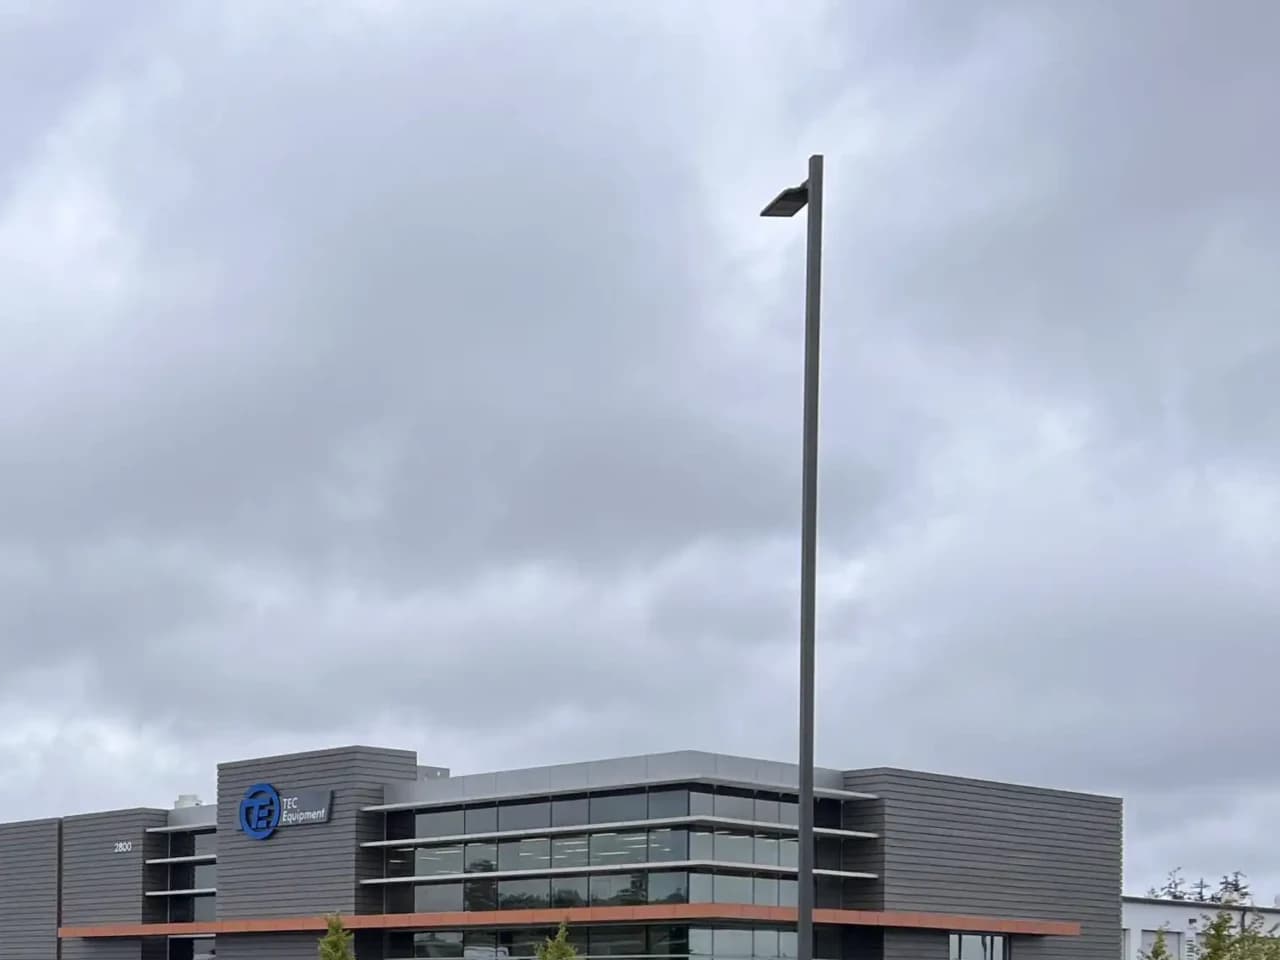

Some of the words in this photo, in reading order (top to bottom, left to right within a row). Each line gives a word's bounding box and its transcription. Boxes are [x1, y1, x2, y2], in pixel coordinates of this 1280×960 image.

[282, 797, 298, 809] TEC
[282, 808, 325, 823] Equipment
[114, 841, 132, 852] 2800
